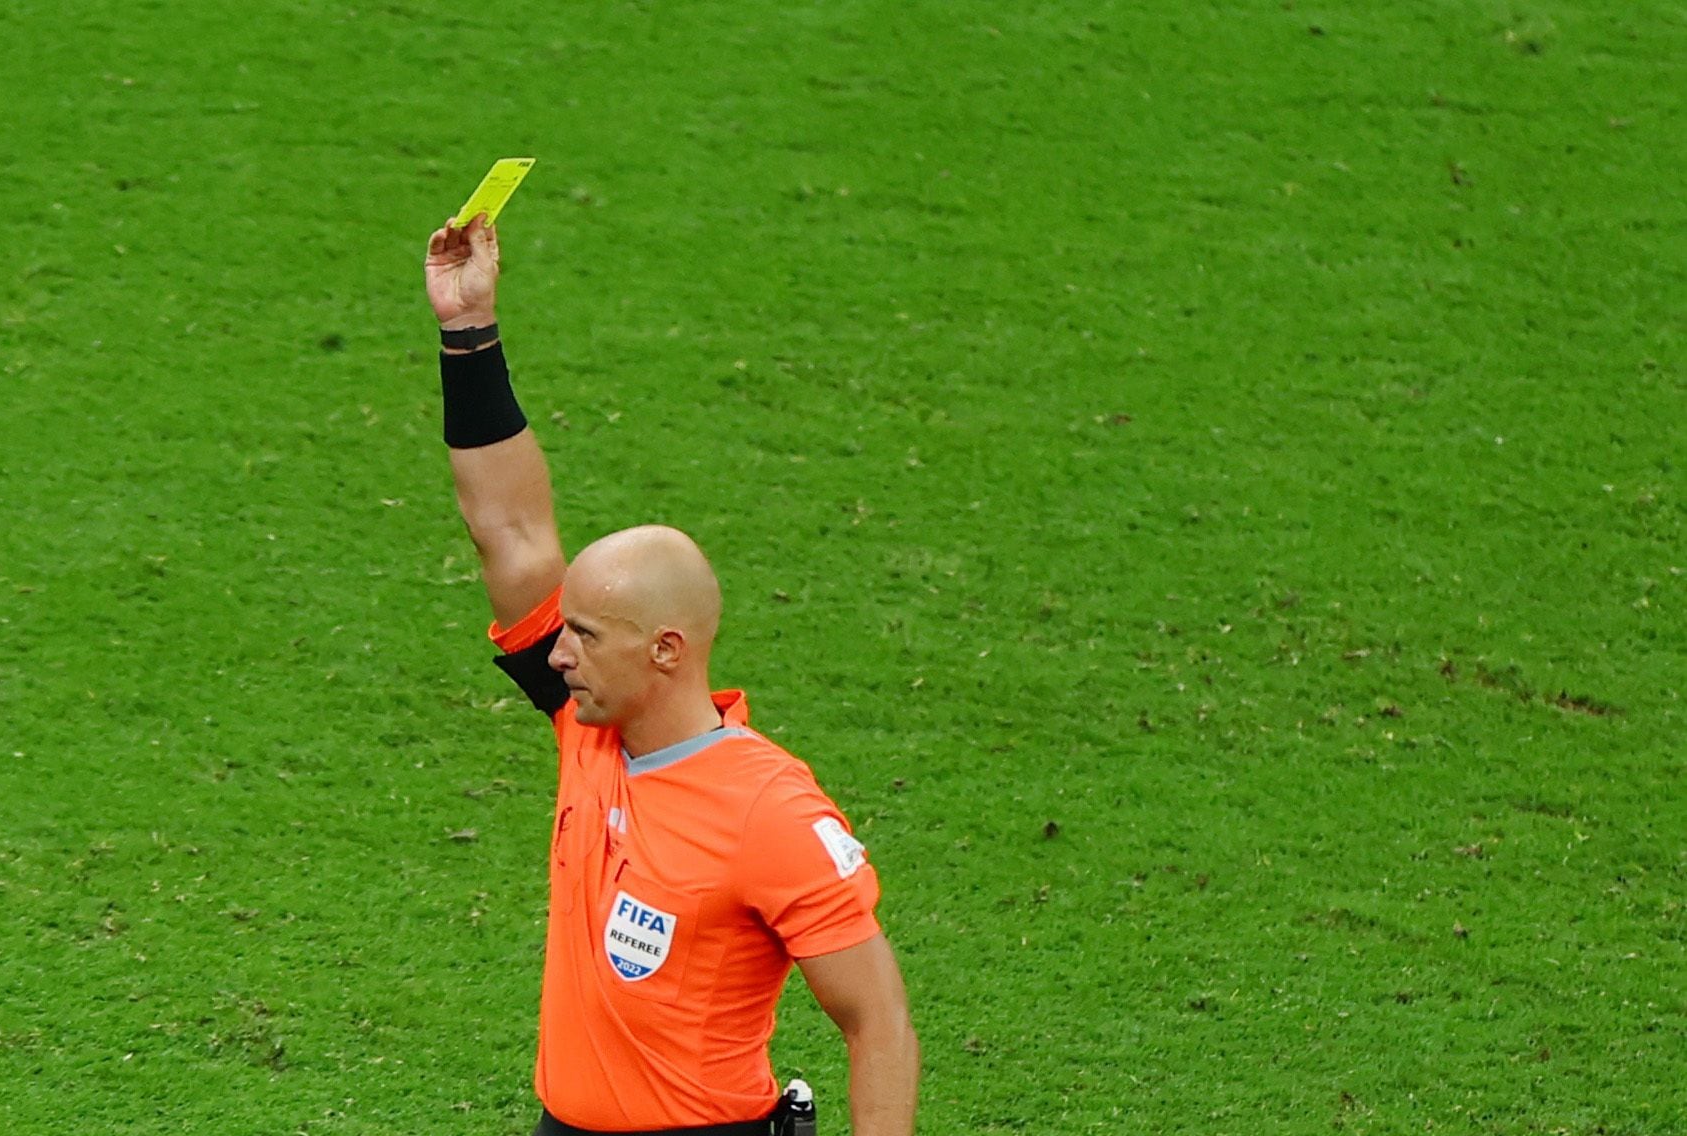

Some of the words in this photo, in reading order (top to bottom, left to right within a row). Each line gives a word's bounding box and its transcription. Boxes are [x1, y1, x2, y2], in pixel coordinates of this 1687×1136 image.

[617, 898, 666, 935] FIFA
[609, 929, 663, 957] REFEREE
[616, 958, 642, 976] 2022
